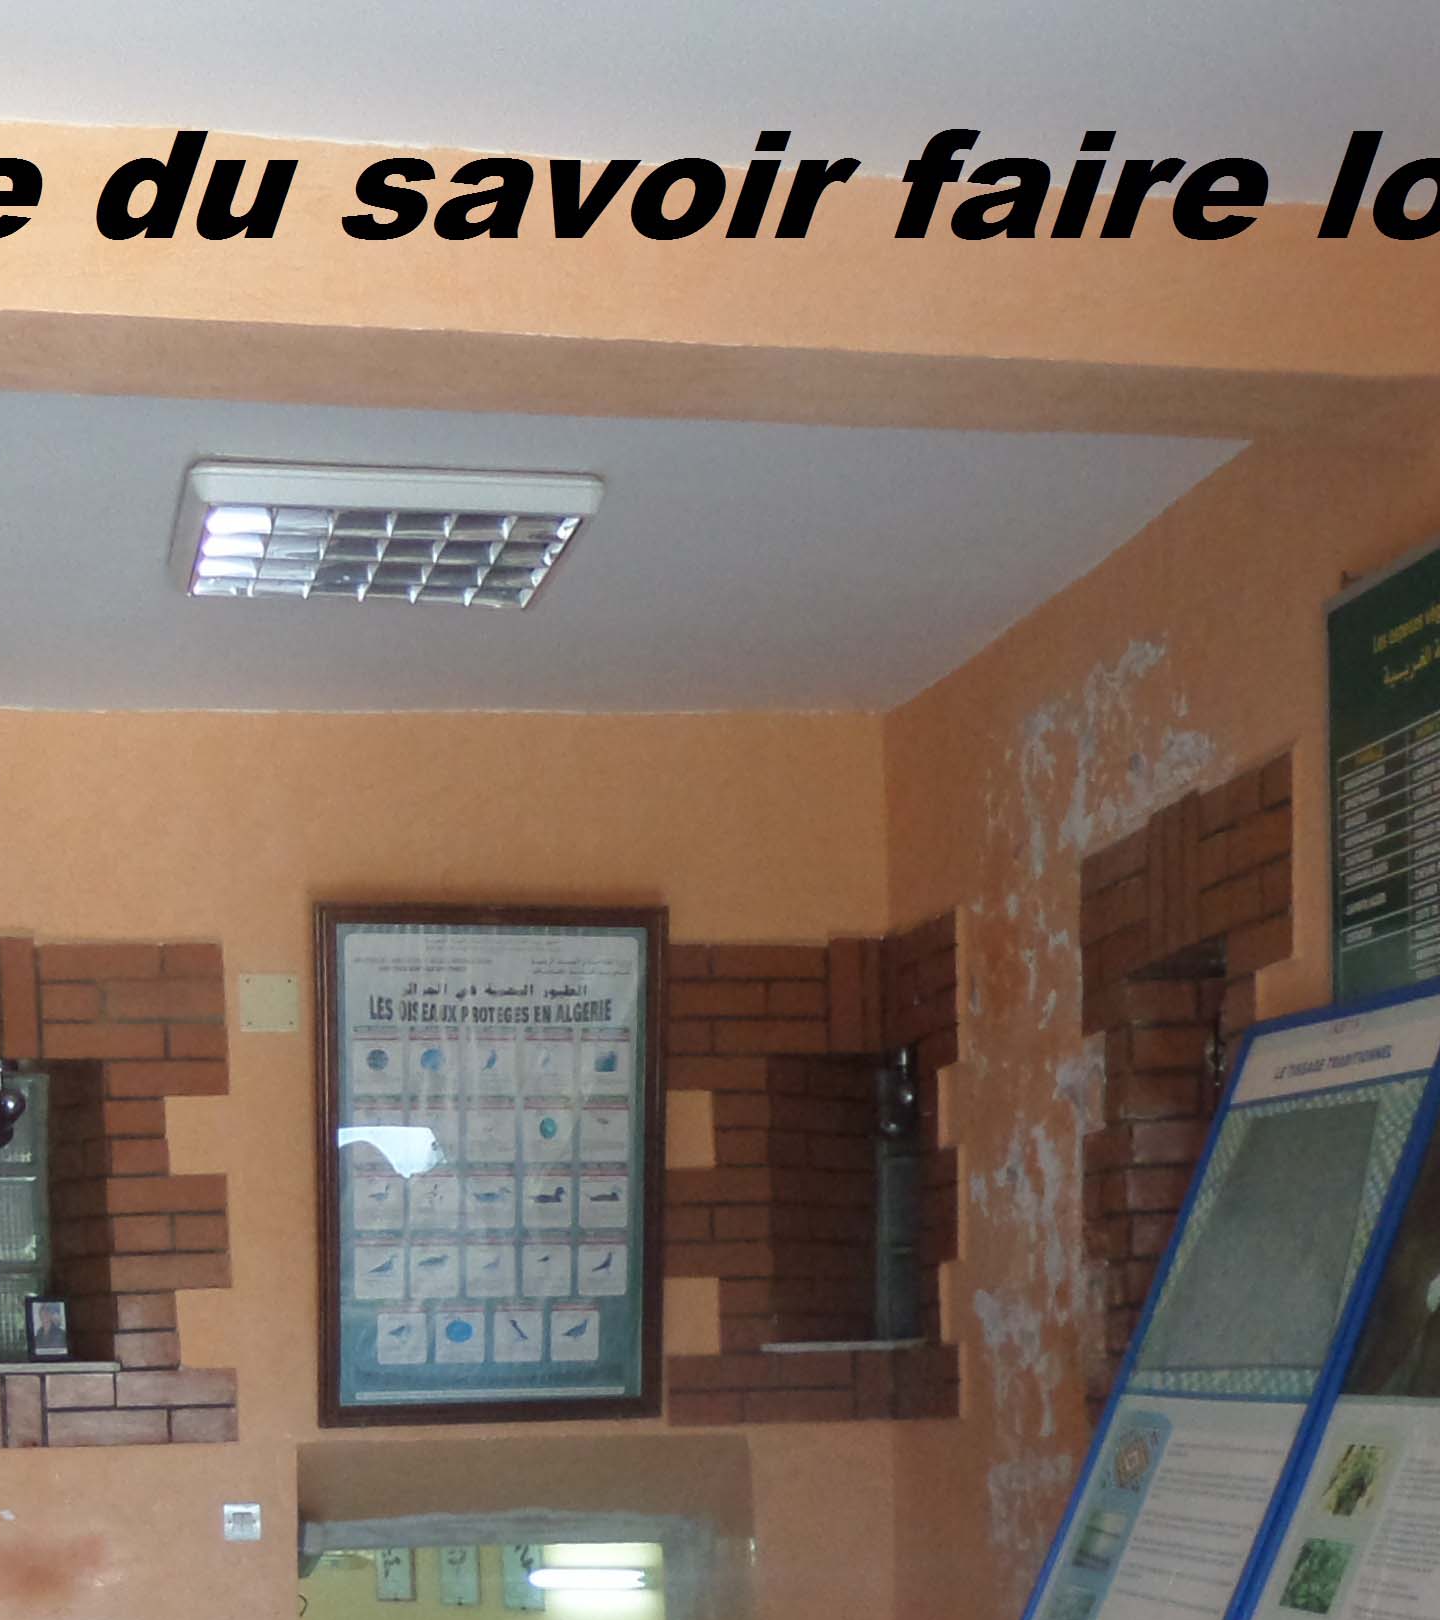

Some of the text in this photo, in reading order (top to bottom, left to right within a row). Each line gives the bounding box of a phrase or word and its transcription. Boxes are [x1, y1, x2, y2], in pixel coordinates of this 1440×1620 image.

[368, 993, 394, 1022] LES
[533, 1003, 553, 1023] EN
[556, 997, 613, 1023] ALGERIE
